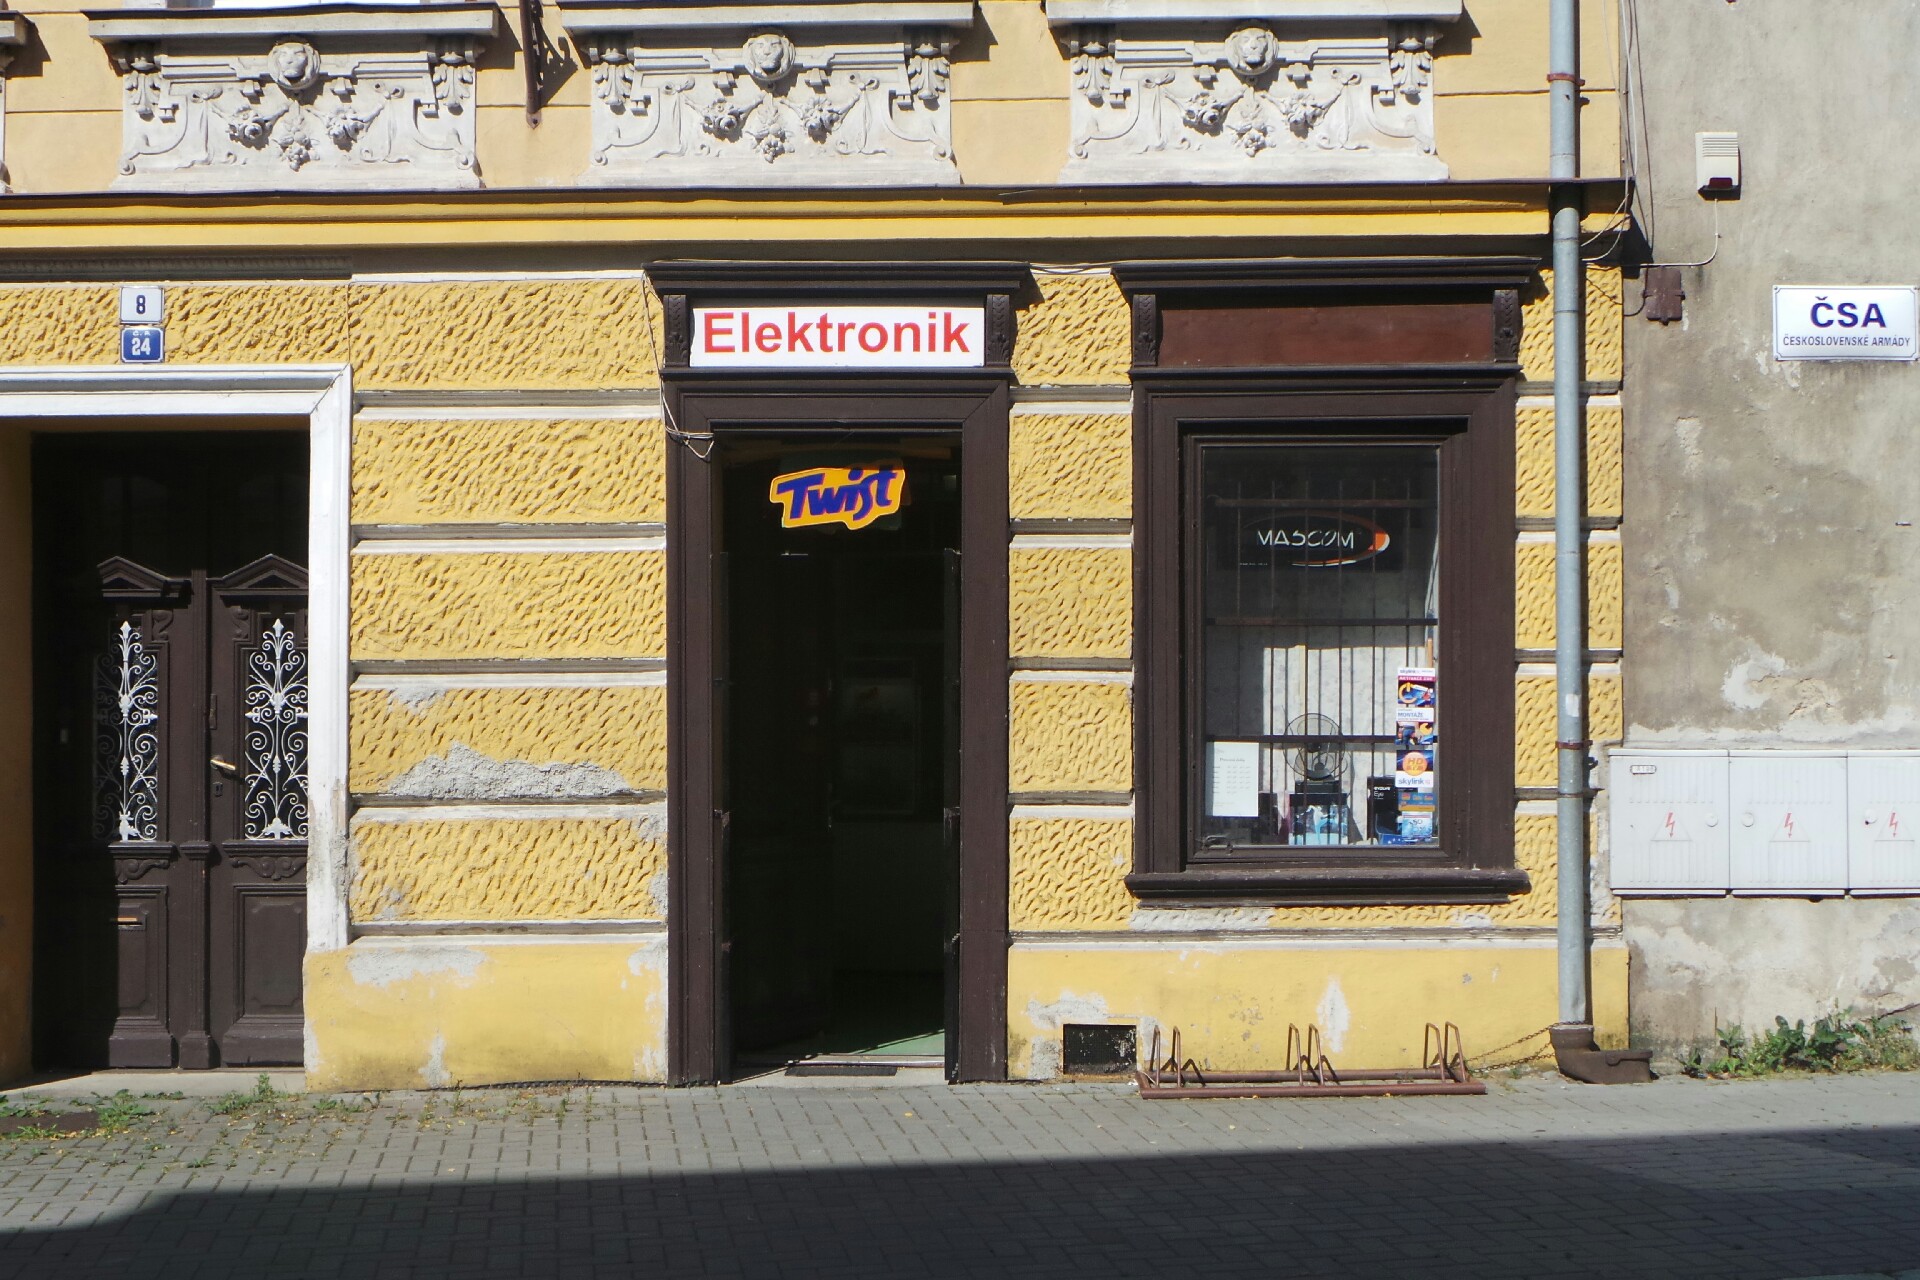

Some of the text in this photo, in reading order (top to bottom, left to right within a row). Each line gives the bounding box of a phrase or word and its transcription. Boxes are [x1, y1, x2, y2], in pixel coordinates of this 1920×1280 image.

[136, 294, 146, 315] 8
[1810, 296, 1887, 328] ČSA
[703, 311, 971, 353] Elektronik
[1783, 333, 1911, 347] ČESKOSLOVENSKÉ ARMÁDY
[131, 337, 151, 356] 24
[776, 465, 898, 521] Twist
[1257, 529, 1354, 549] MASCOM
[1398, 777, 1424, 786] skylink
